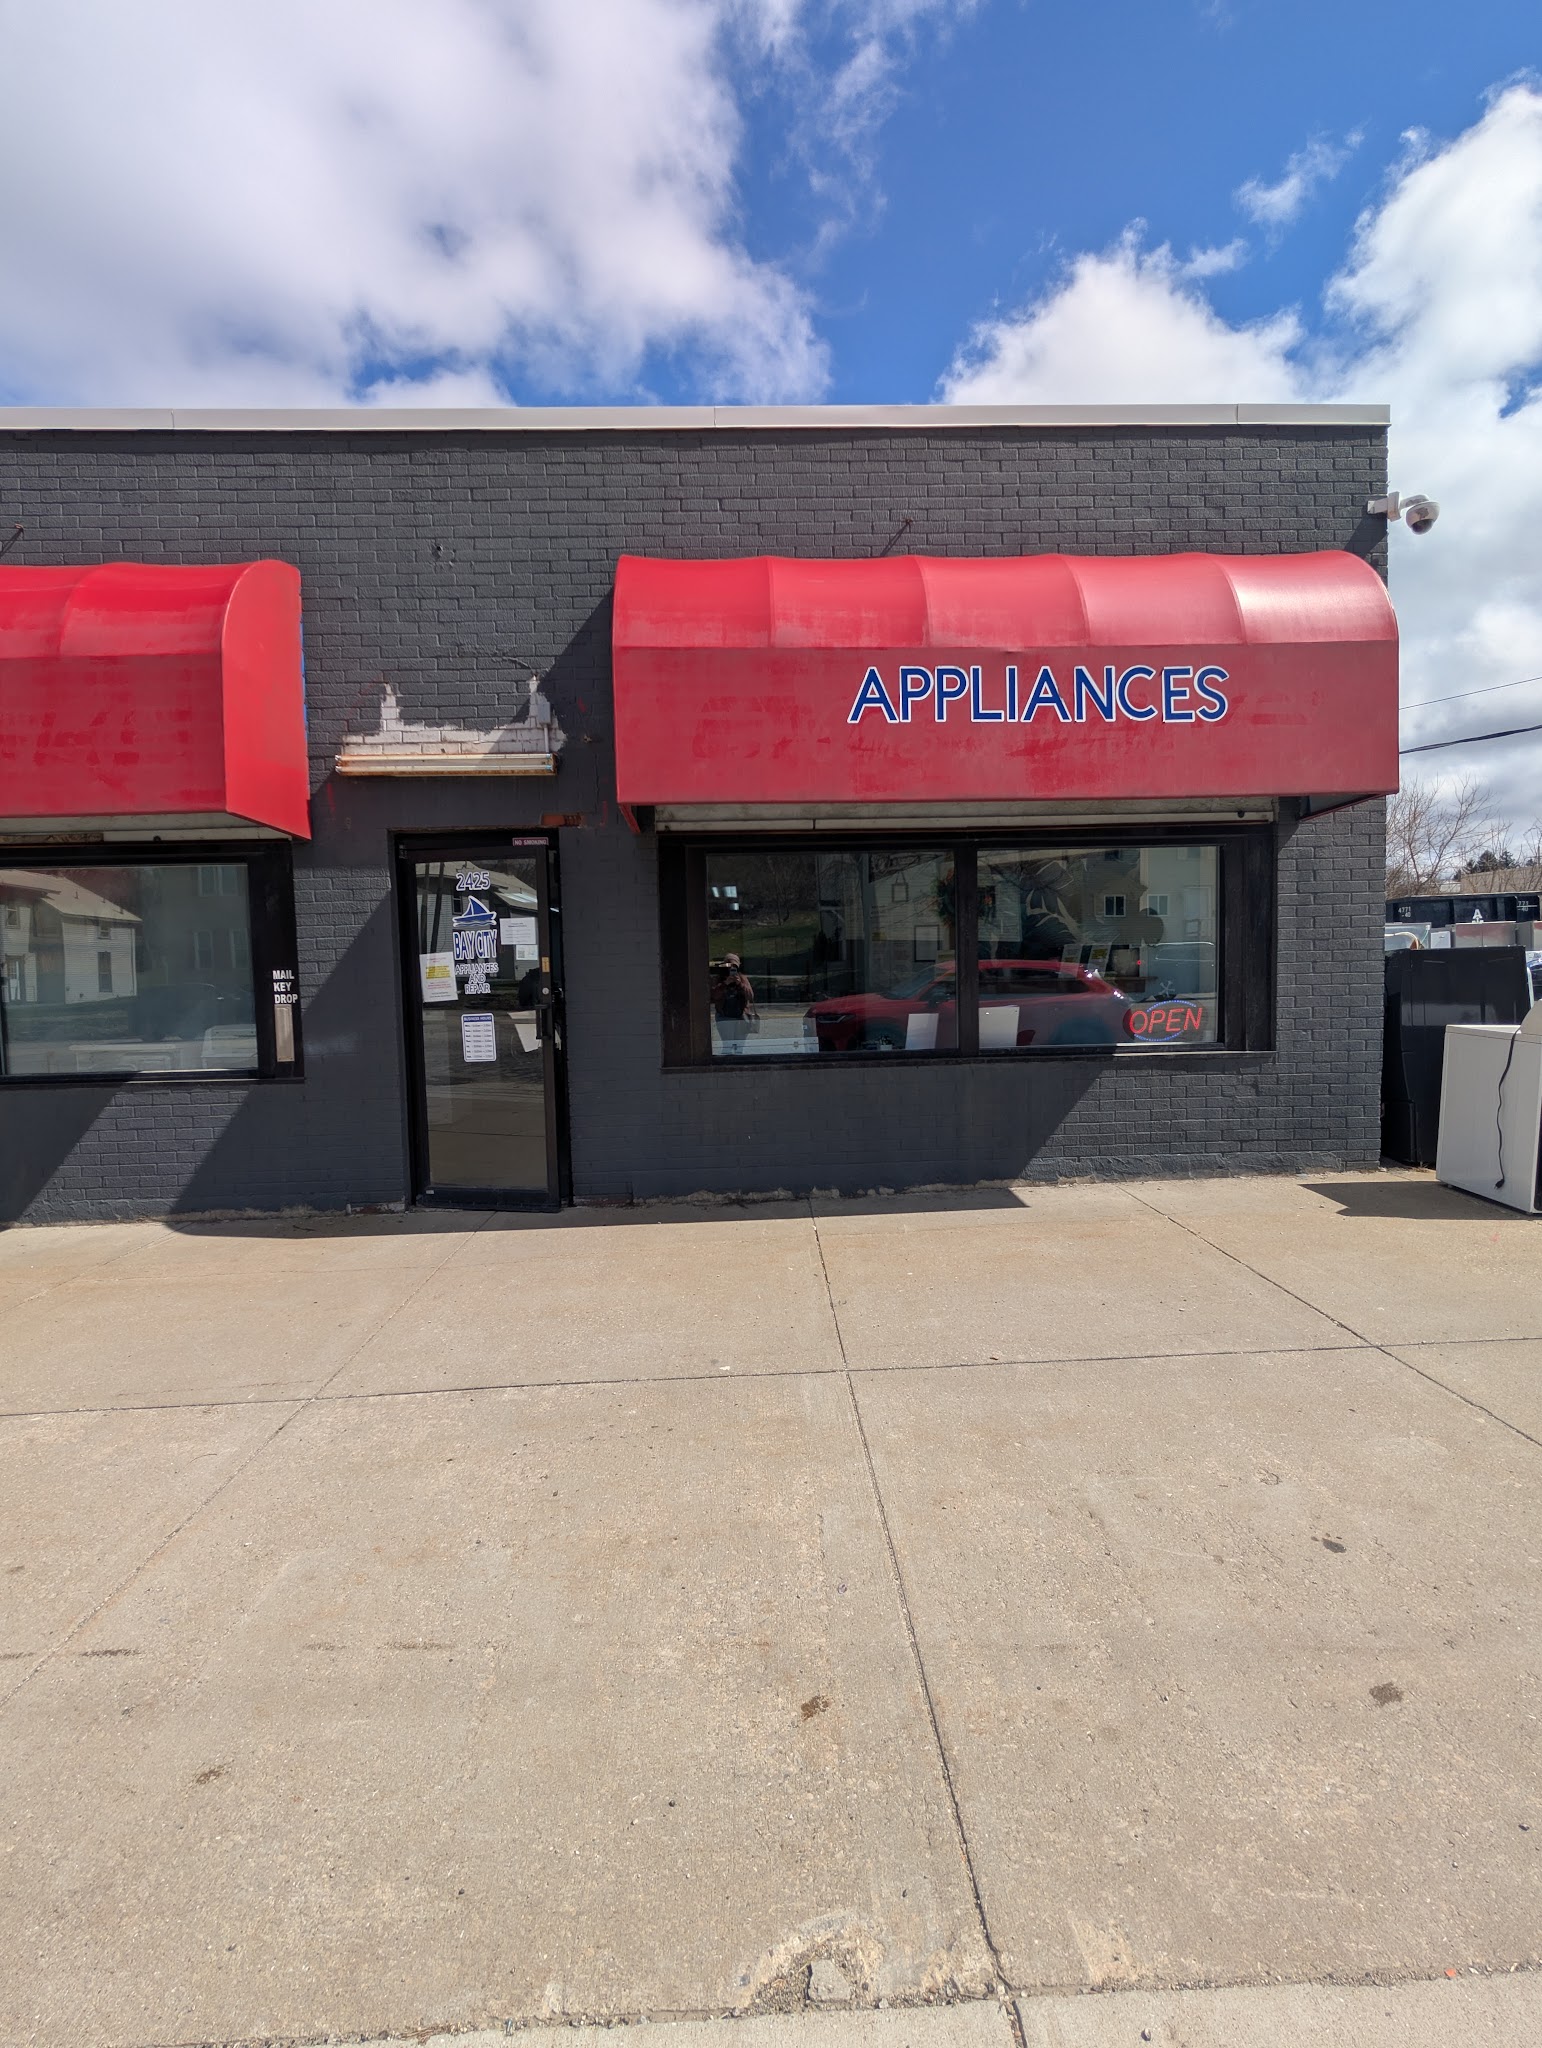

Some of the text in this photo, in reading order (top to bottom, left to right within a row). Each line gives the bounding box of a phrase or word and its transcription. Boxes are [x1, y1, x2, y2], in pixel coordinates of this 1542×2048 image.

[847, 665, 1230, 724] APPLIANCES
[456, 871, 491, 892] 2425
[1472, 908, 1483, 920] A
[453, 930, 475, 960] BAY
[475, 929, 497, 959] CITY
[272, 969, 295, 980] MAIL
[455, 962, 499, 976] APPLIANCES
[468, 973, 486, 985] AND
[273, 981, 291, 992] KEY
[464, 982, 491, 995] REPAIR
[274, 993, 298, 1004] DROP
[1129, 1007, 1203, 1034] OPEN
